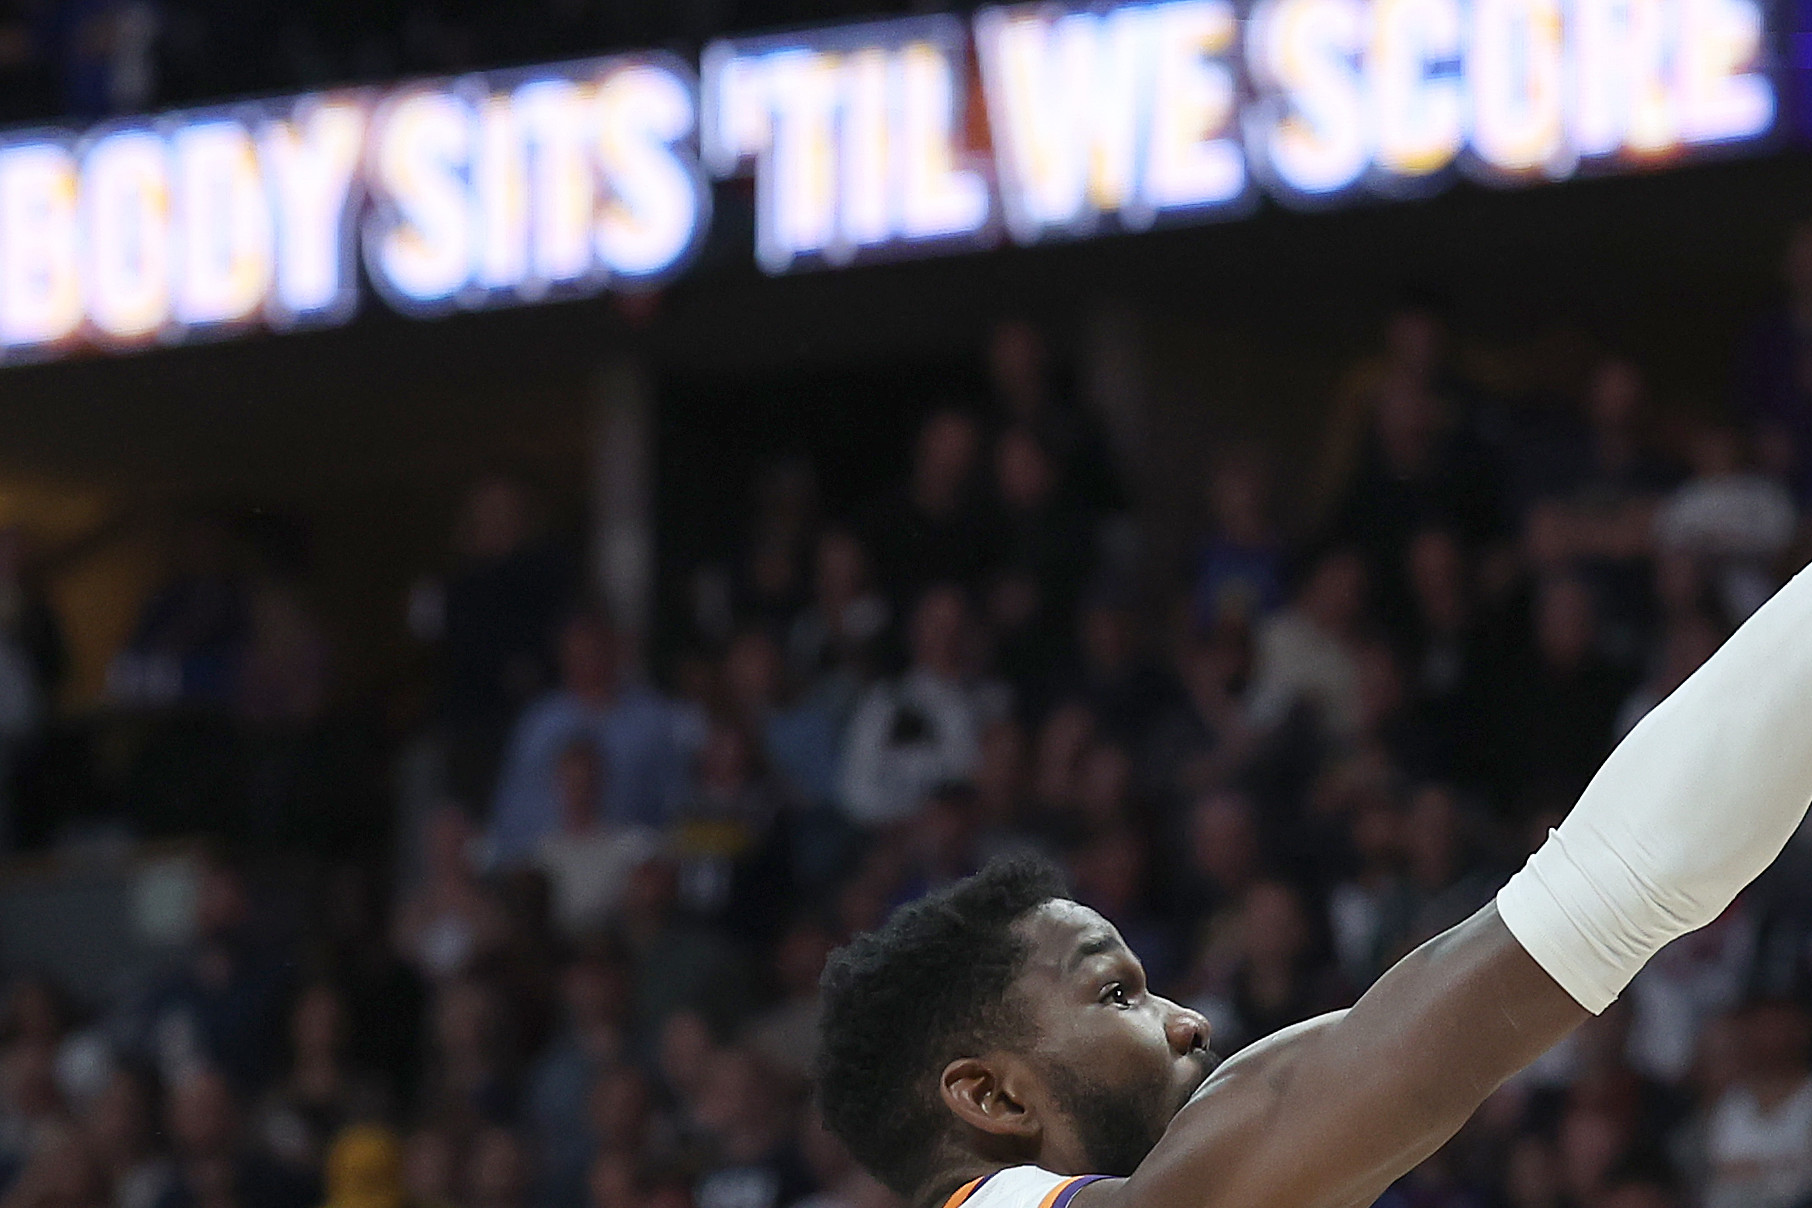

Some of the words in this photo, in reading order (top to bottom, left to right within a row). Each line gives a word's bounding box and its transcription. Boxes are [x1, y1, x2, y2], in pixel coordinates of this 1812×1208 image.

[370, 64, 704, 308] SITS
[980, 10, 1247, 228] WE
[1252, 0, 1778, 196] SCORE
